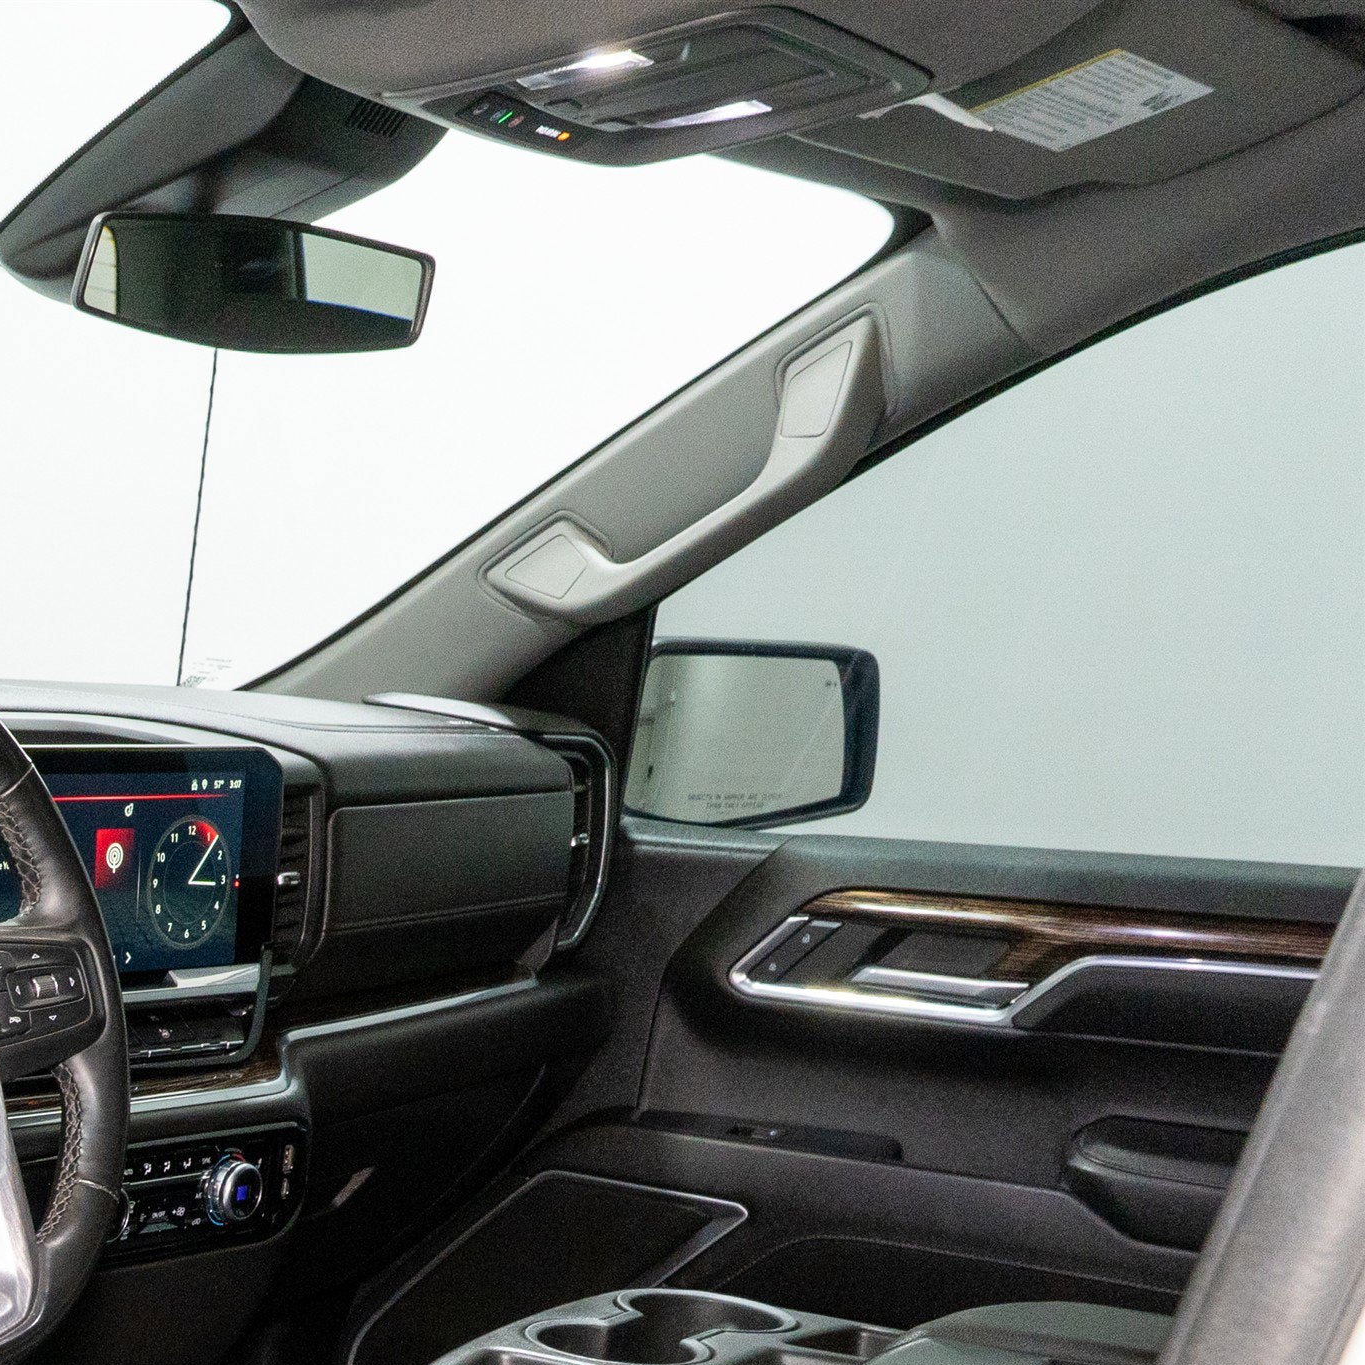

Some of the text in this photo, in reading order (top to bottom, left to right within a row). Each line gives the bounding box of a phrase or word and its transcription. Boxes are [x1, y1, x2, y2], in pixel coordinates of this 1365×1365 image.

[229, 779, 242, 789] 3:07
[188, 825, 197, 836] 12
[171, 833, 179, 843] 11
[206, 832, 211, 842] 1
[157, 852, 166, 863] 10
[217, 850, 222, 860] 2
[153, 878, 158, 888] 9
[221, 874, 226, 885] 3
[155, 904, 161, 914] 8
[214, 901, 219, 910] 4
[167, 922, 173, 932] 7
[201, 920, 206, 931] 5
[184, 928, 189, 939] 6
